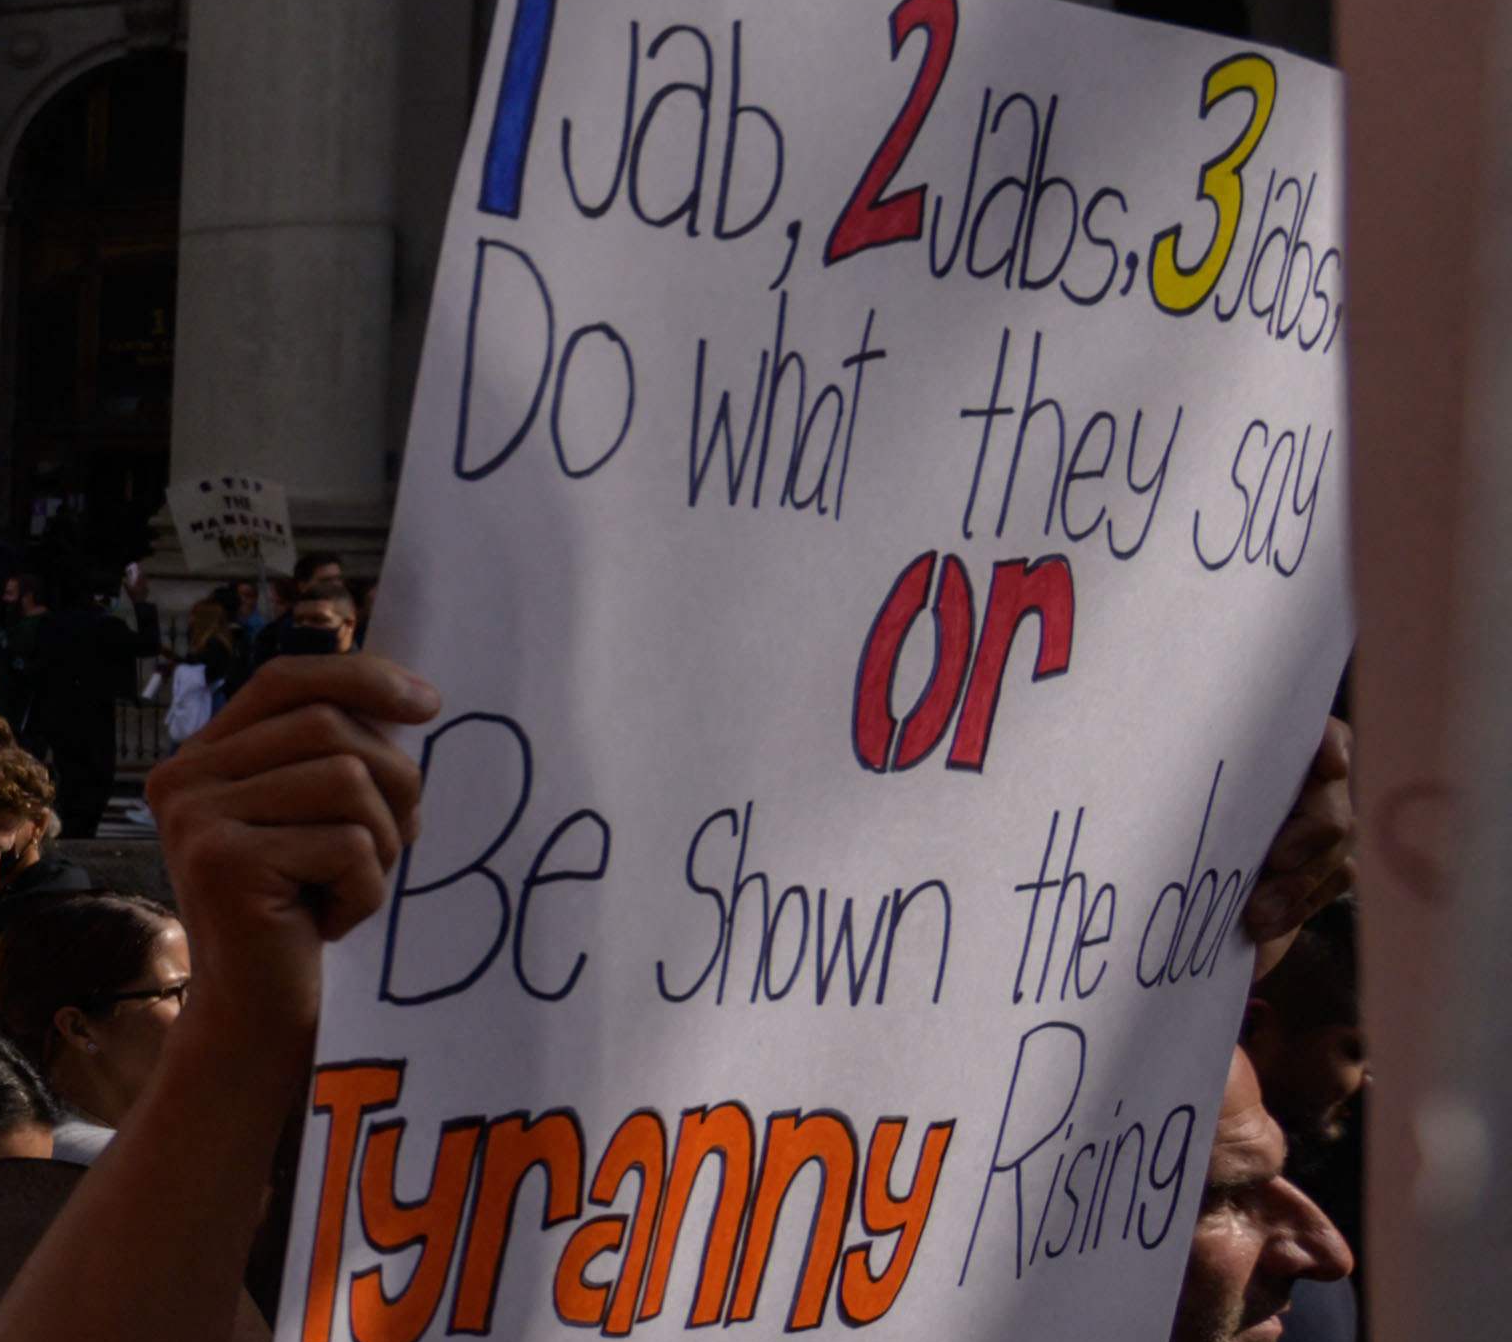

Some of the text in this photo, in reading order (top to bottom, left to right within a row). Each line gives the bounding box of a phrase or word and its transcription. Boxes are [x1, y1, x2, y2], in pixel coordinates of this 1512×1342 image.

[1146, 52, 1277, 317] 3
[223, 495, 250, 510] THE
[454, 237, 636, 481] Do
[959, 327, 1184, 560] they
[1194, 417, 1333, 578] say
[379, 712, 613, 1007] Be
[656, 801, 952, 1007] Shown
[1012, 806, 1120, 1007] the
[959, 1021, 1196, 1288] Rising
